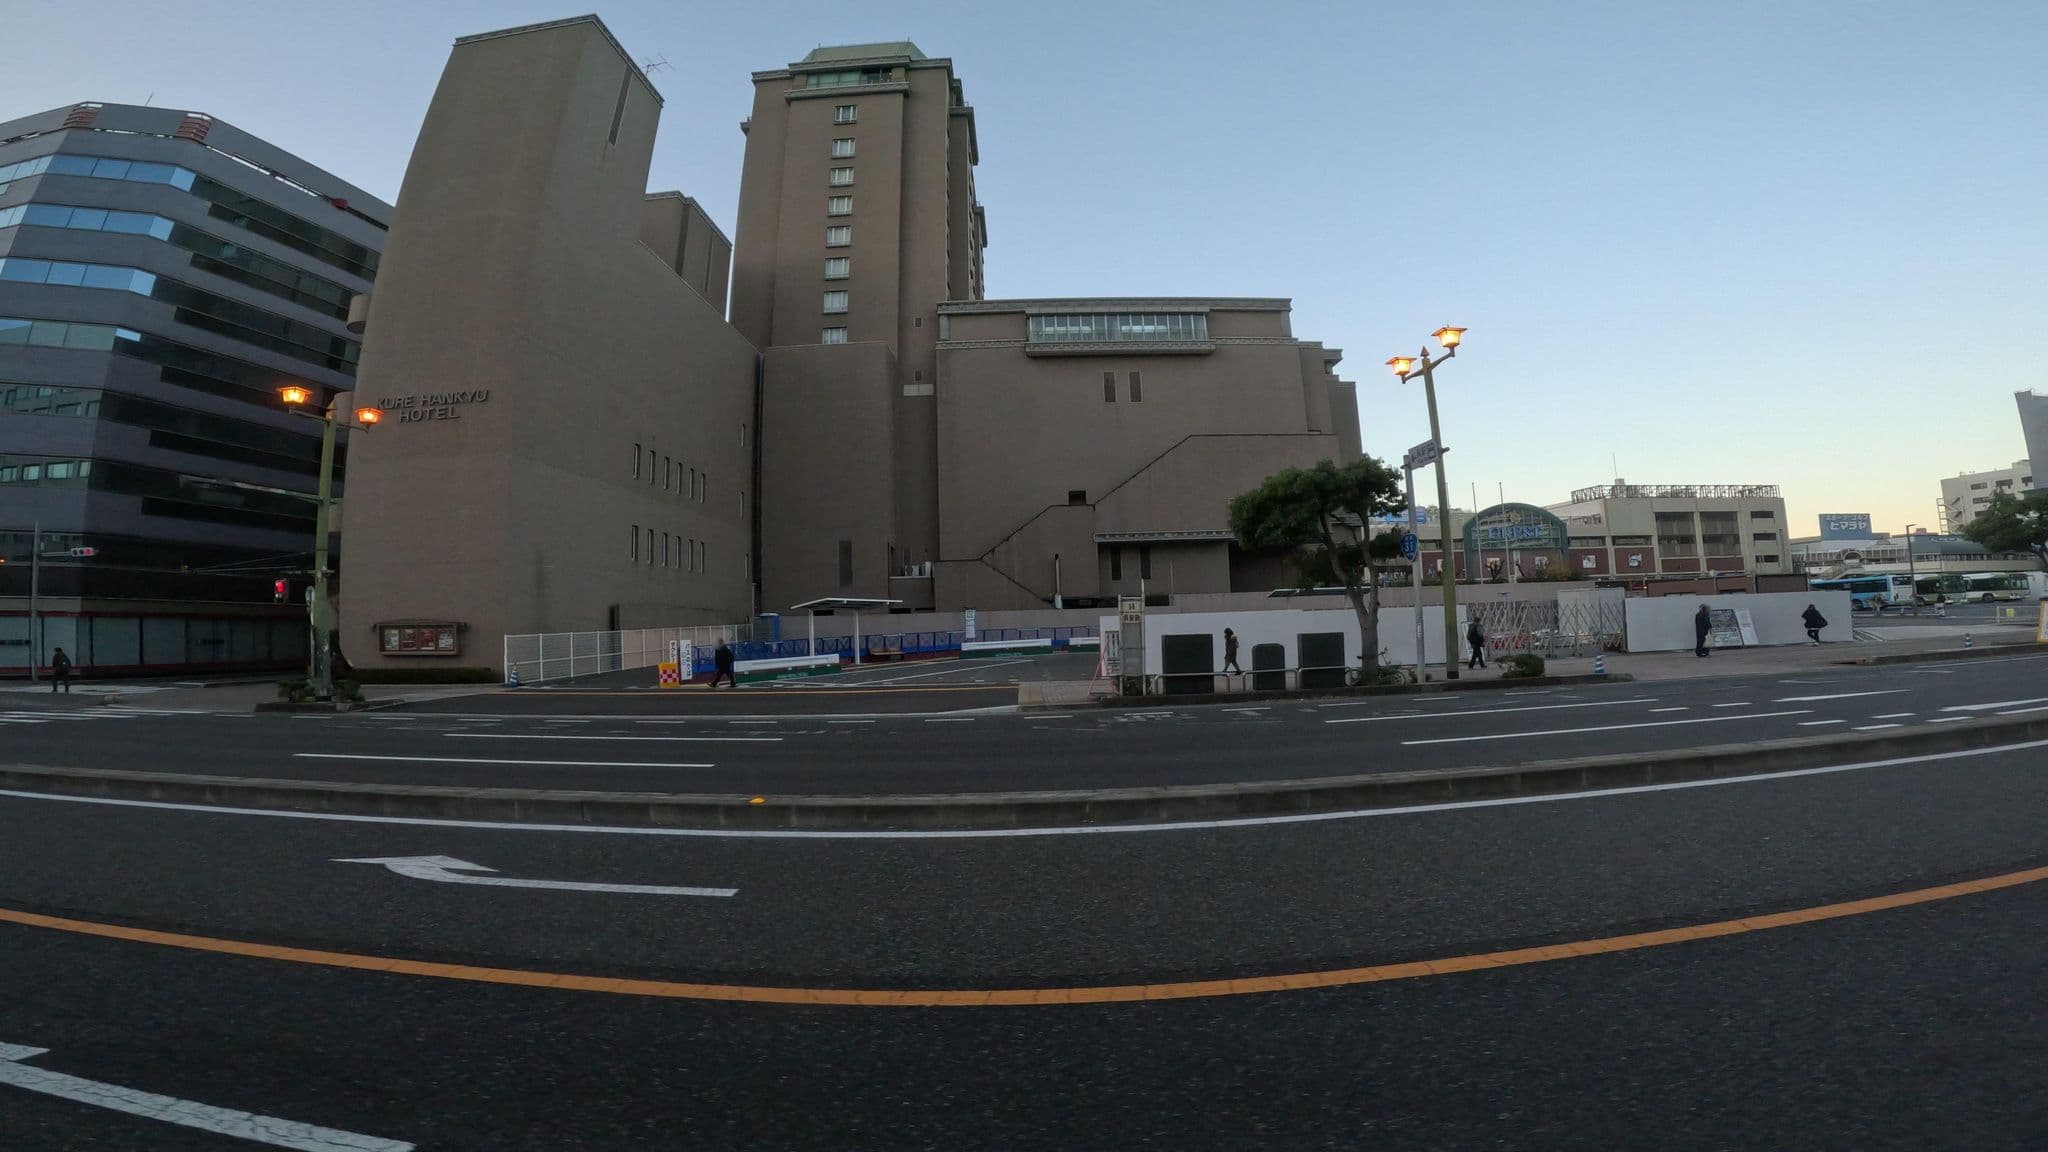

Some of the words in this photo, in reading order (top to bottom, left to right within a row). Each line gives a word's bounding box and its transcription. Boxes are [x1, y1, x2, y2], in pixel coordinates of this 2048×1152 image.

[377, 396, 414, 409] KURE
[421, 389, 489, 407] HANKYU
[400, 407, 461, 423] HOTEL
[1830, 521, 1867, 531] ヒマラヤ
